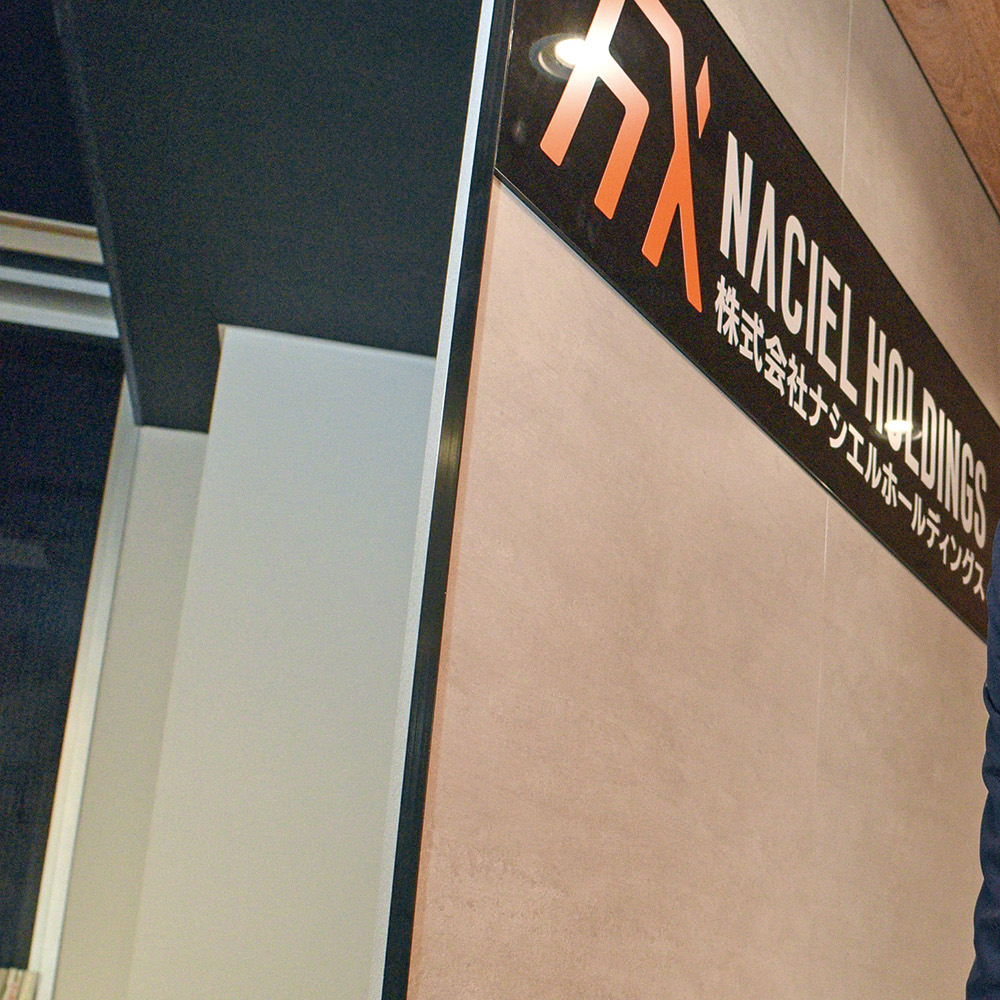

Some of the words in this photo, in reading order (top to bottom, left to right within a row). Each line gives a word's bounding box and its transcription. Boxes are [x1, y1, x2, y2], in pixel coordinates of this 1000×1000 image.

[714, 274, 986, 601] 株式会社ナシエルホールディングス
[865, 316, 987, 549] HOLDINGS
